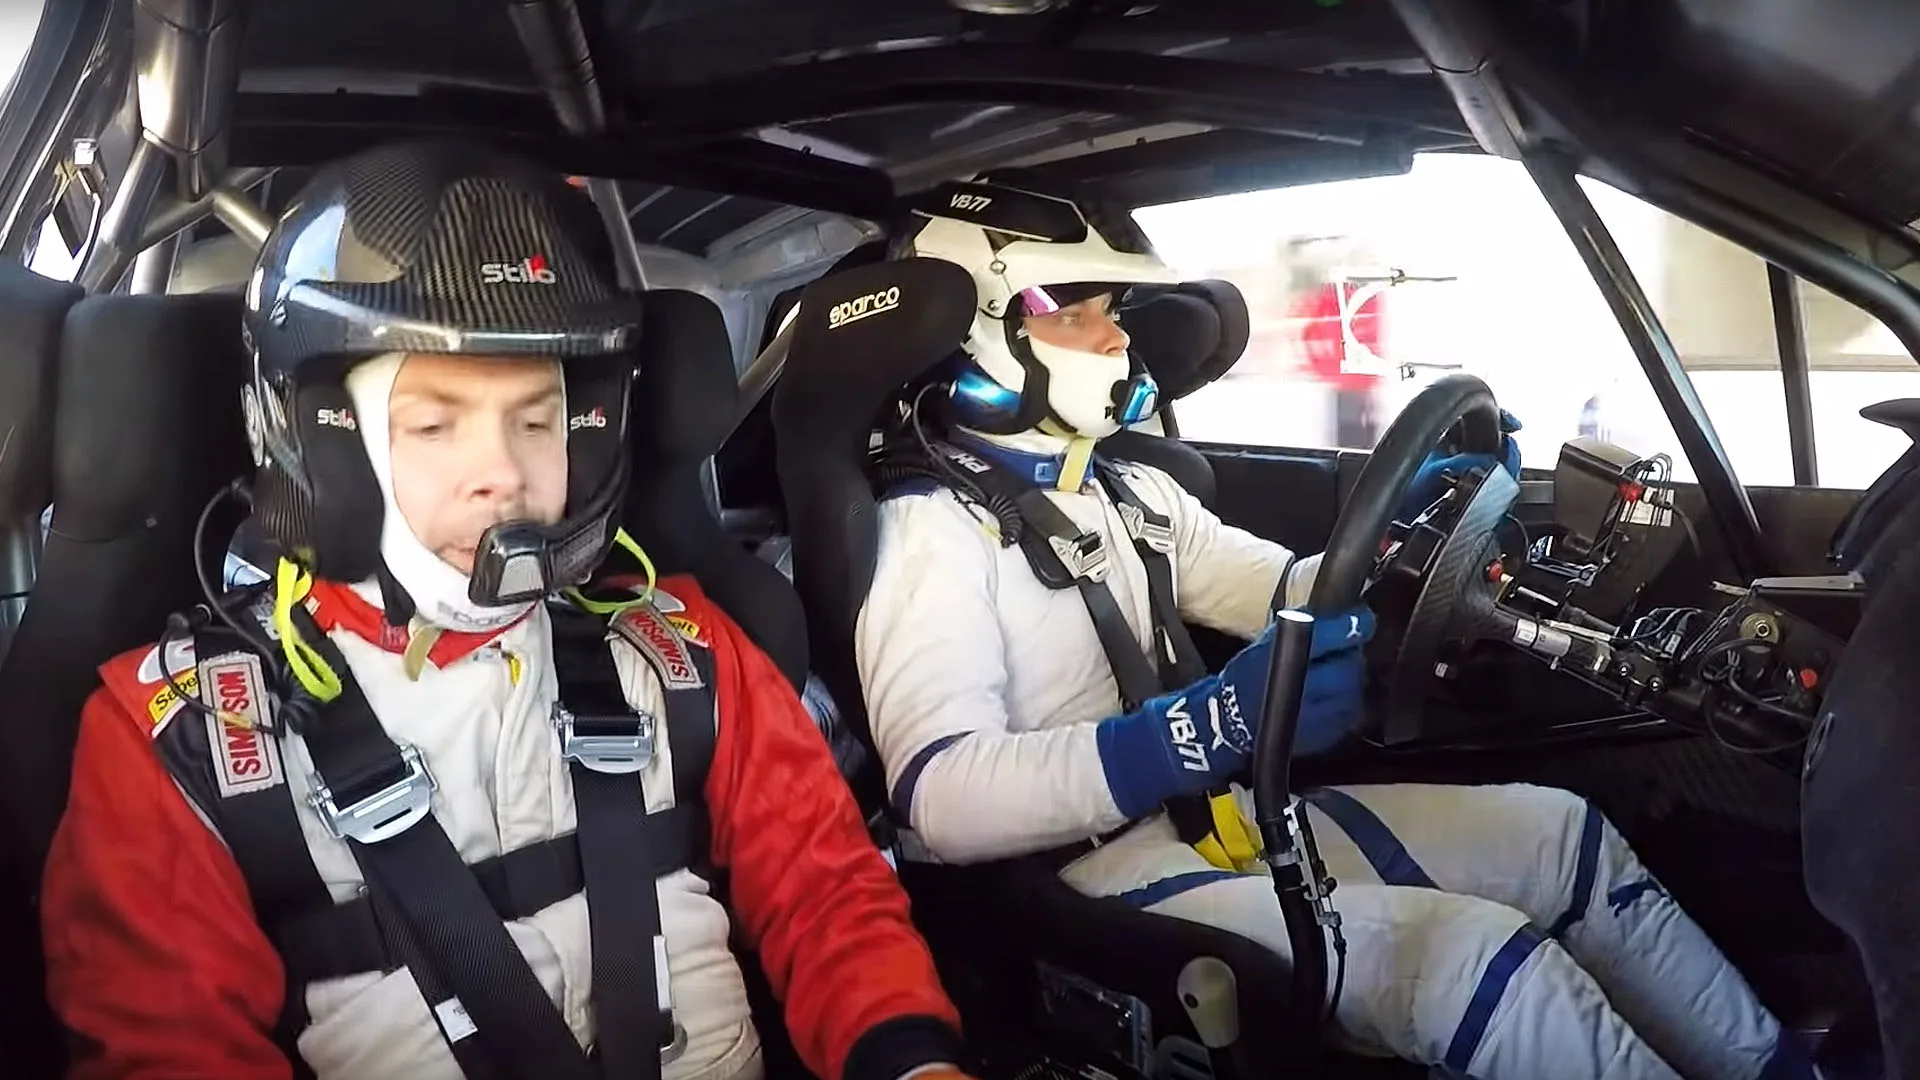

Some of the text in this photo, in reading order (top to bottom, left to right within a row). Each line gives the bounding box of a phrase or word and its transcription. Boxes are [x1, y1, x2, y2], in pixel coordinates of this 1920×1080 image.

[950, 193, 993, 212] VB77
[481, 256, 556, 284] Stilo
[829, 286, 900, 327] sparco
[317, 408, 356, 431] Stilo
[570, 408, 607, 430] Stilo
[155, 669, 199, 711] Sabe
[217, 671, 261, 776] SIMSON
[1166, 697, 1210, 771] VB77
